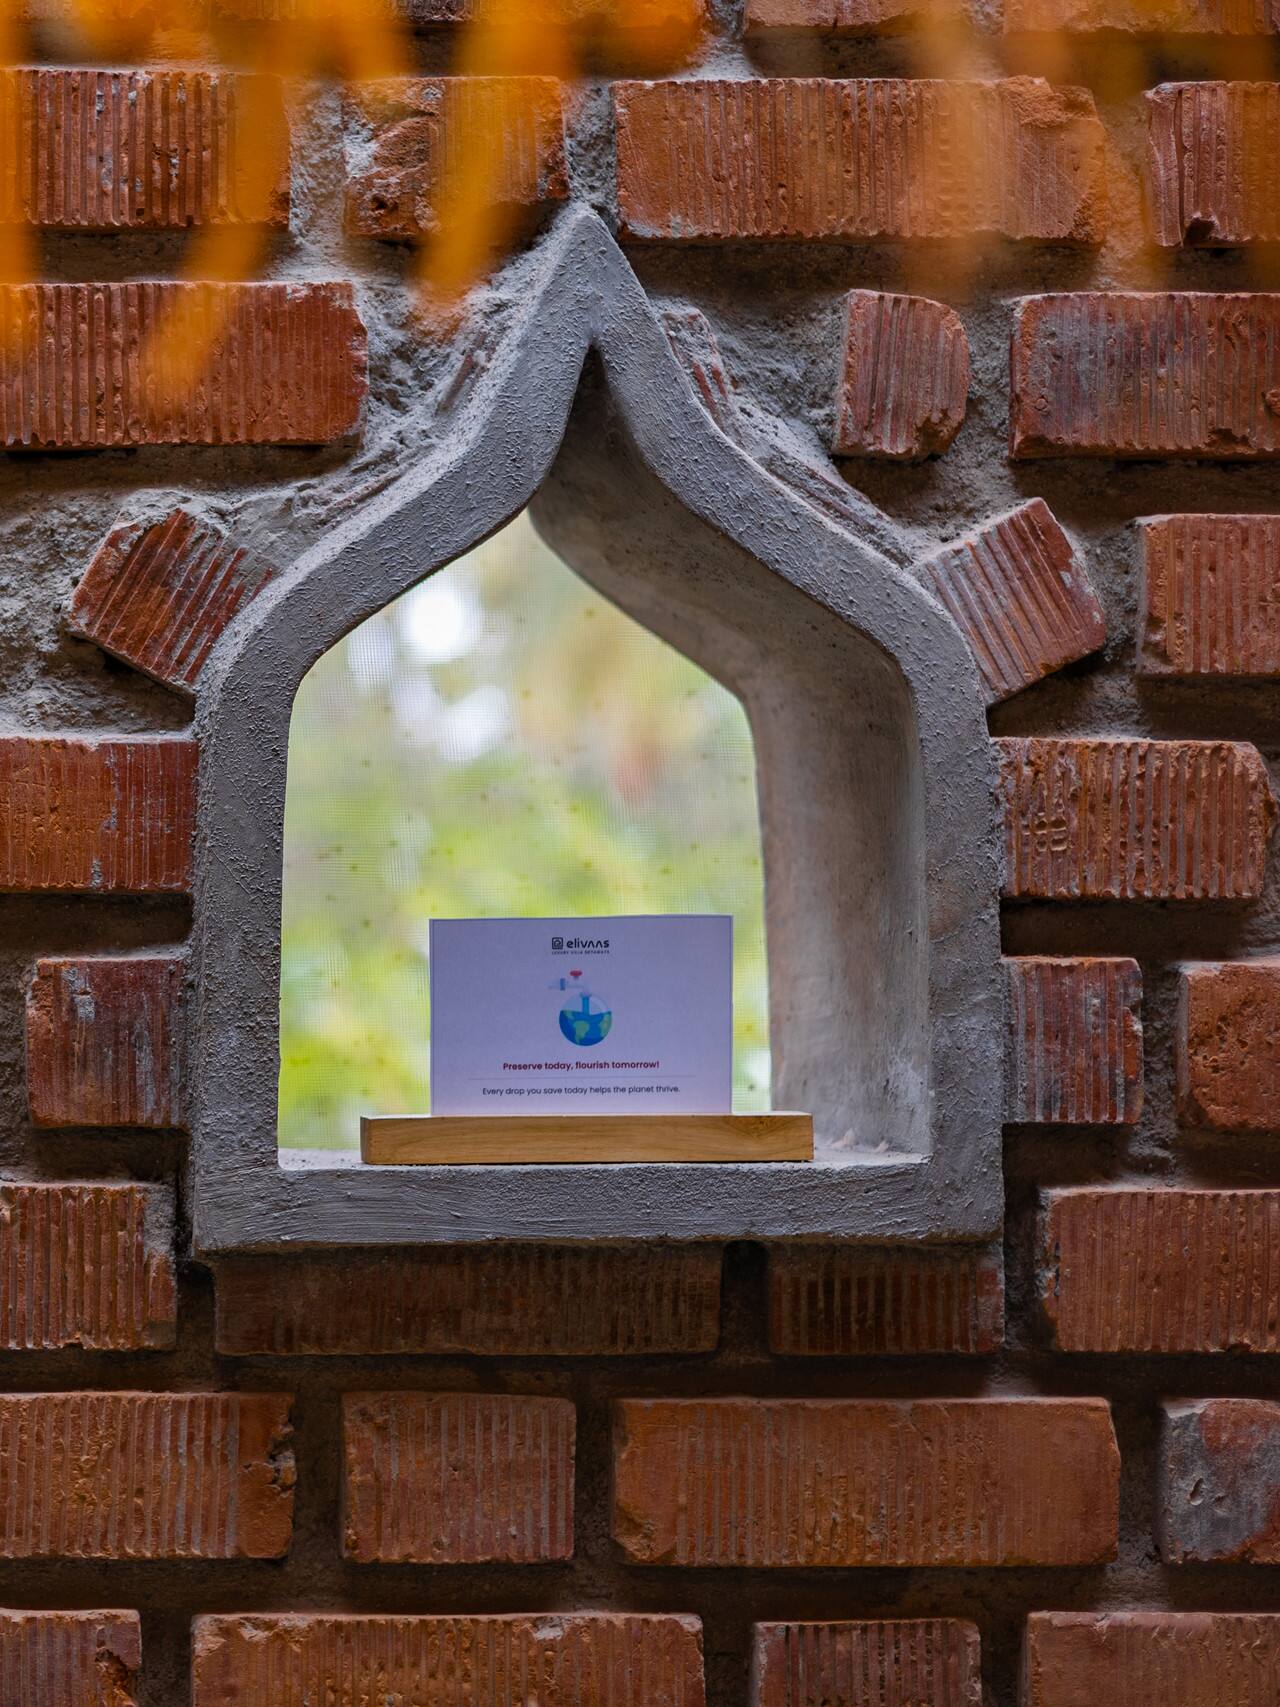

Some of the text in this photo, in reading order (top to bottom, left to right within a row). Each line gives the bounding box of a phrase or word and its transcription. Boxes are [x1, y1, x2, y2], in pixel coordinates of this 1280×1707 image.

[566, 937, 610, 949] elivaas
[503, 1060, 660, 1072] Preserve today, flourish tomorrow!
[483, 1087, 504, 1096] Every
[505, 1087, 525, 1096] drop
[526, 1087, 542, 1096] you
[564, 1086, 588, 1095] today
[589, 1086, 611, 1095] helps
[628, 1085, 655, 1094] planet
[656, 1085, 681, 1093] thrive.
